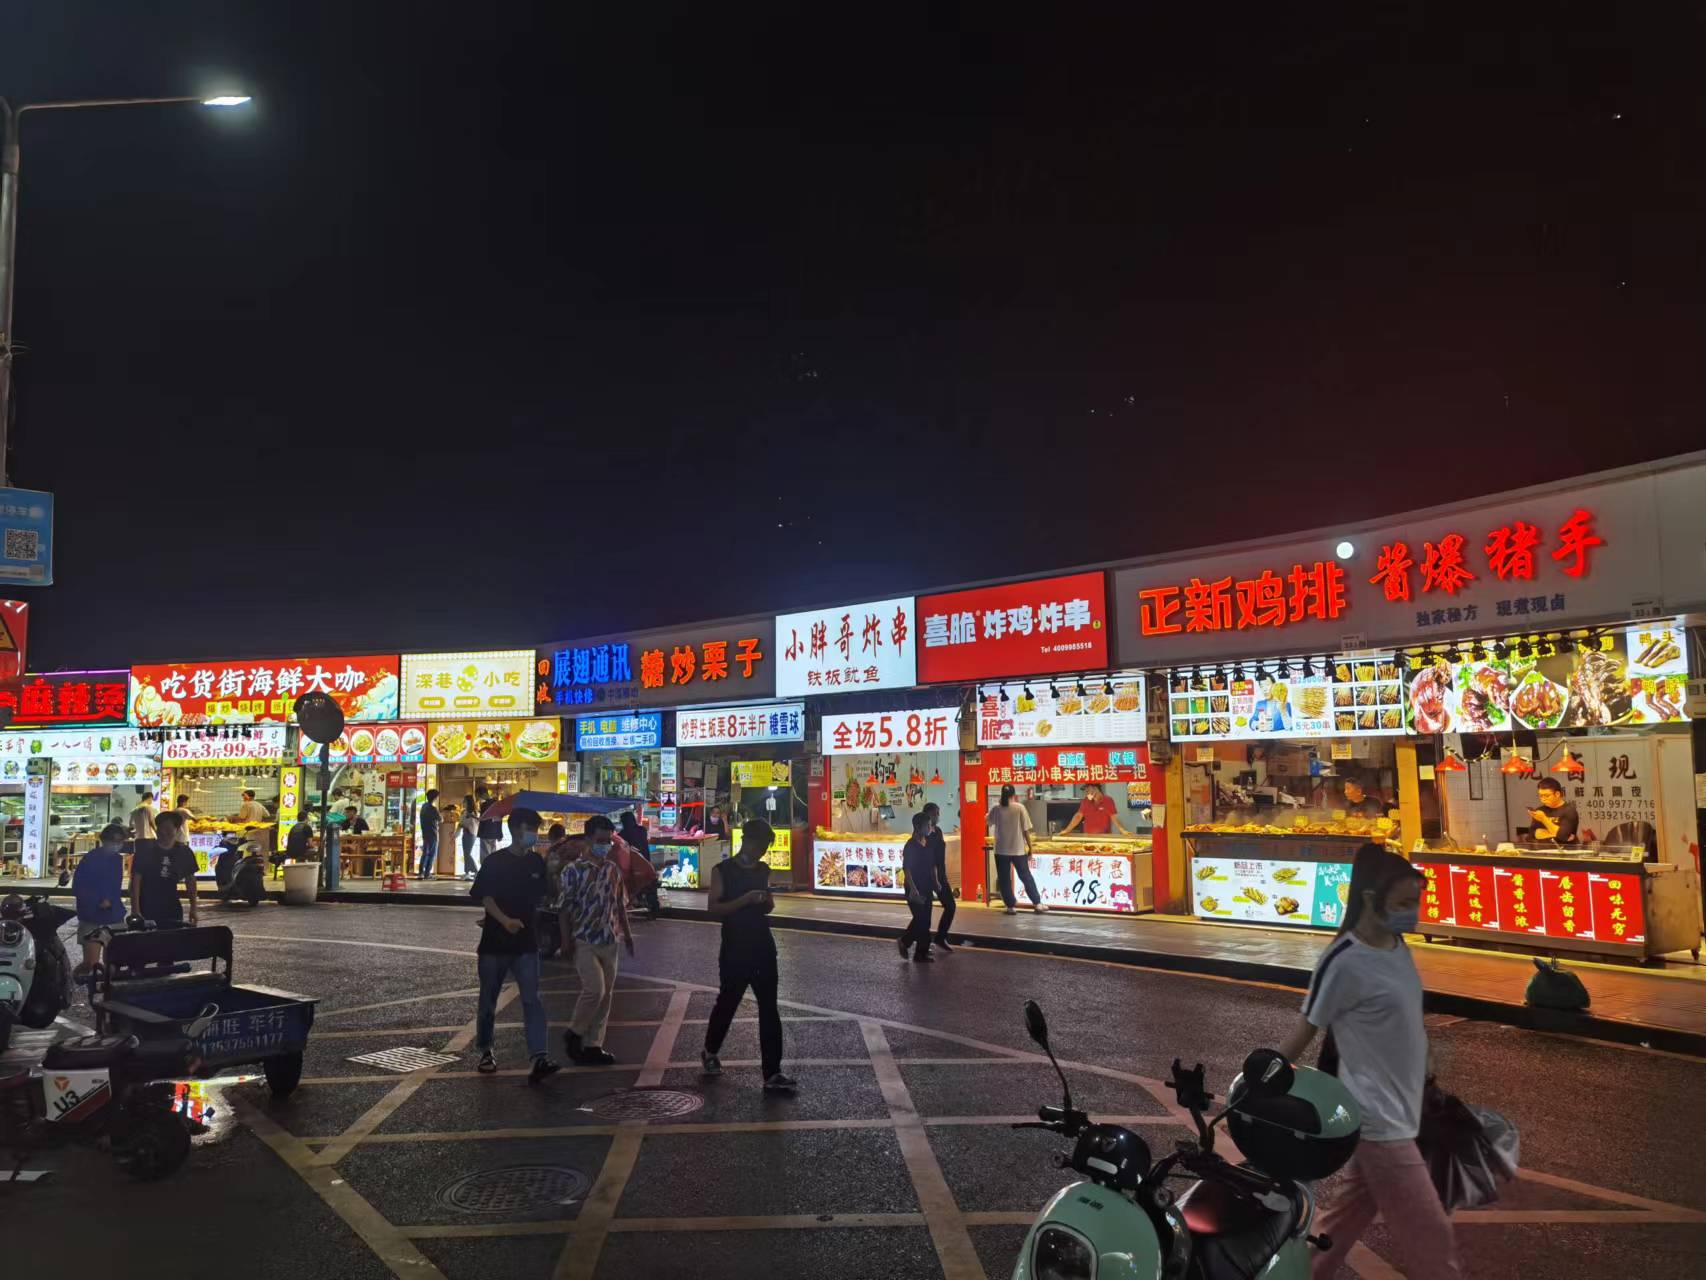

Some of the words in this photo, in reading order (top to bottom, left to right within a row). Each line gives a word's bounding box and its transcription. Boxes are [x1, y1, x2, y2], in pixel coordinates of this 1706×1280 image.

[1369, 508, 1605, 602] 酱爆猪手
[1139, 560, 1346, 637] 正新鸡排
[1416, 604, 1479, 627] 独家秘方
[785, 605, 908, 662] 小胖哥炸串
[922, 611, 976, 648] 喜脆
[416, 673, 453, 688] 深巷
[483, 671, 520, 687] 小吃
[553, 643, 631, 688] 展翅通讯
[640, 638, 763, 690] 糖炒栗子
[807, 665, 880, 687] 铁板鱿鱼
[160, 664, 366, 700] 吃货街海鲜大咖
[580, 722, 595, 734] 手机
[600, 721, 617, 733] 电脑
[621, 716, 657, 732] 维修中心
[681, 714, 766, 740] 炒野生板栗8元半斤
[769, 712, 799, 735] 糖雪球
[832, 716, 948, 750] 全场5.8折
[167, 743, 280, 758] 65元3斤99元5斤
[1109, 751, 1136, 765] 收银
[1587, 800, 1605, 809] 400
[1608, 800, 1633, 809] 9977
[1051, 857, 1124, 879] 暑期特惠
[1511, 874, 1529, 928] 酱香味浓
[1607, 879, 1627, 937] 回味无穷
